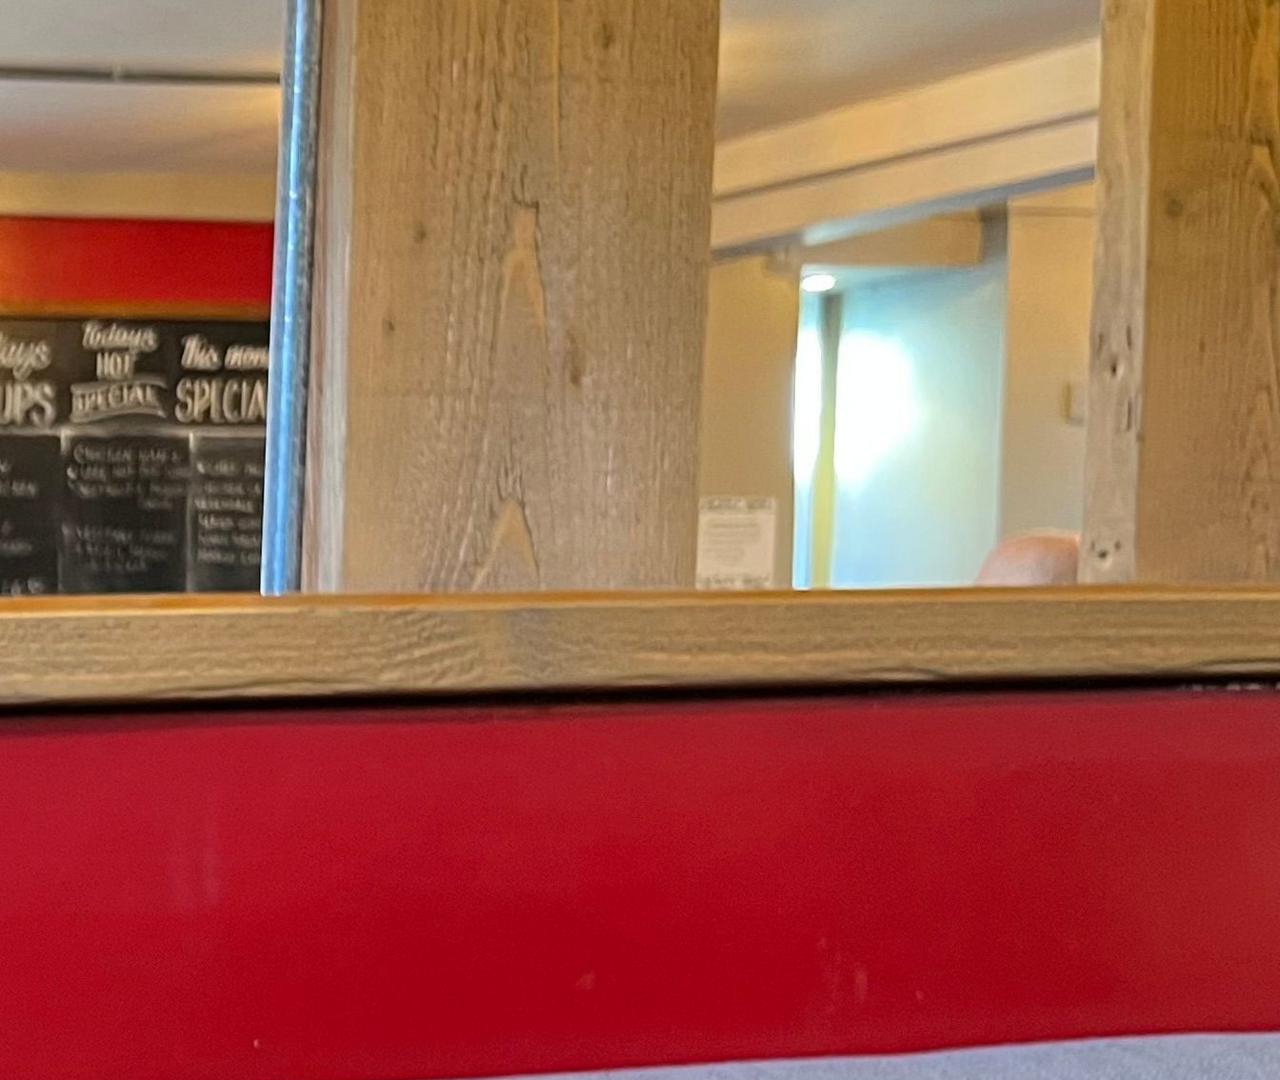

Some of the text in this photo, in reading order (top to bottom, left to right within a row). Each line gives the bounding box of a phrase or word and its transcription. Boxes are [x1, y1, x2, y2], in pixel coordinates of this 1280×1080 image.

[95, 351, 137, 379] HOT
[224, 344, 269, 370] mon
[73, 384, 157, 413] SPECIAL
[175, 378, 267, 424] SPECIA
